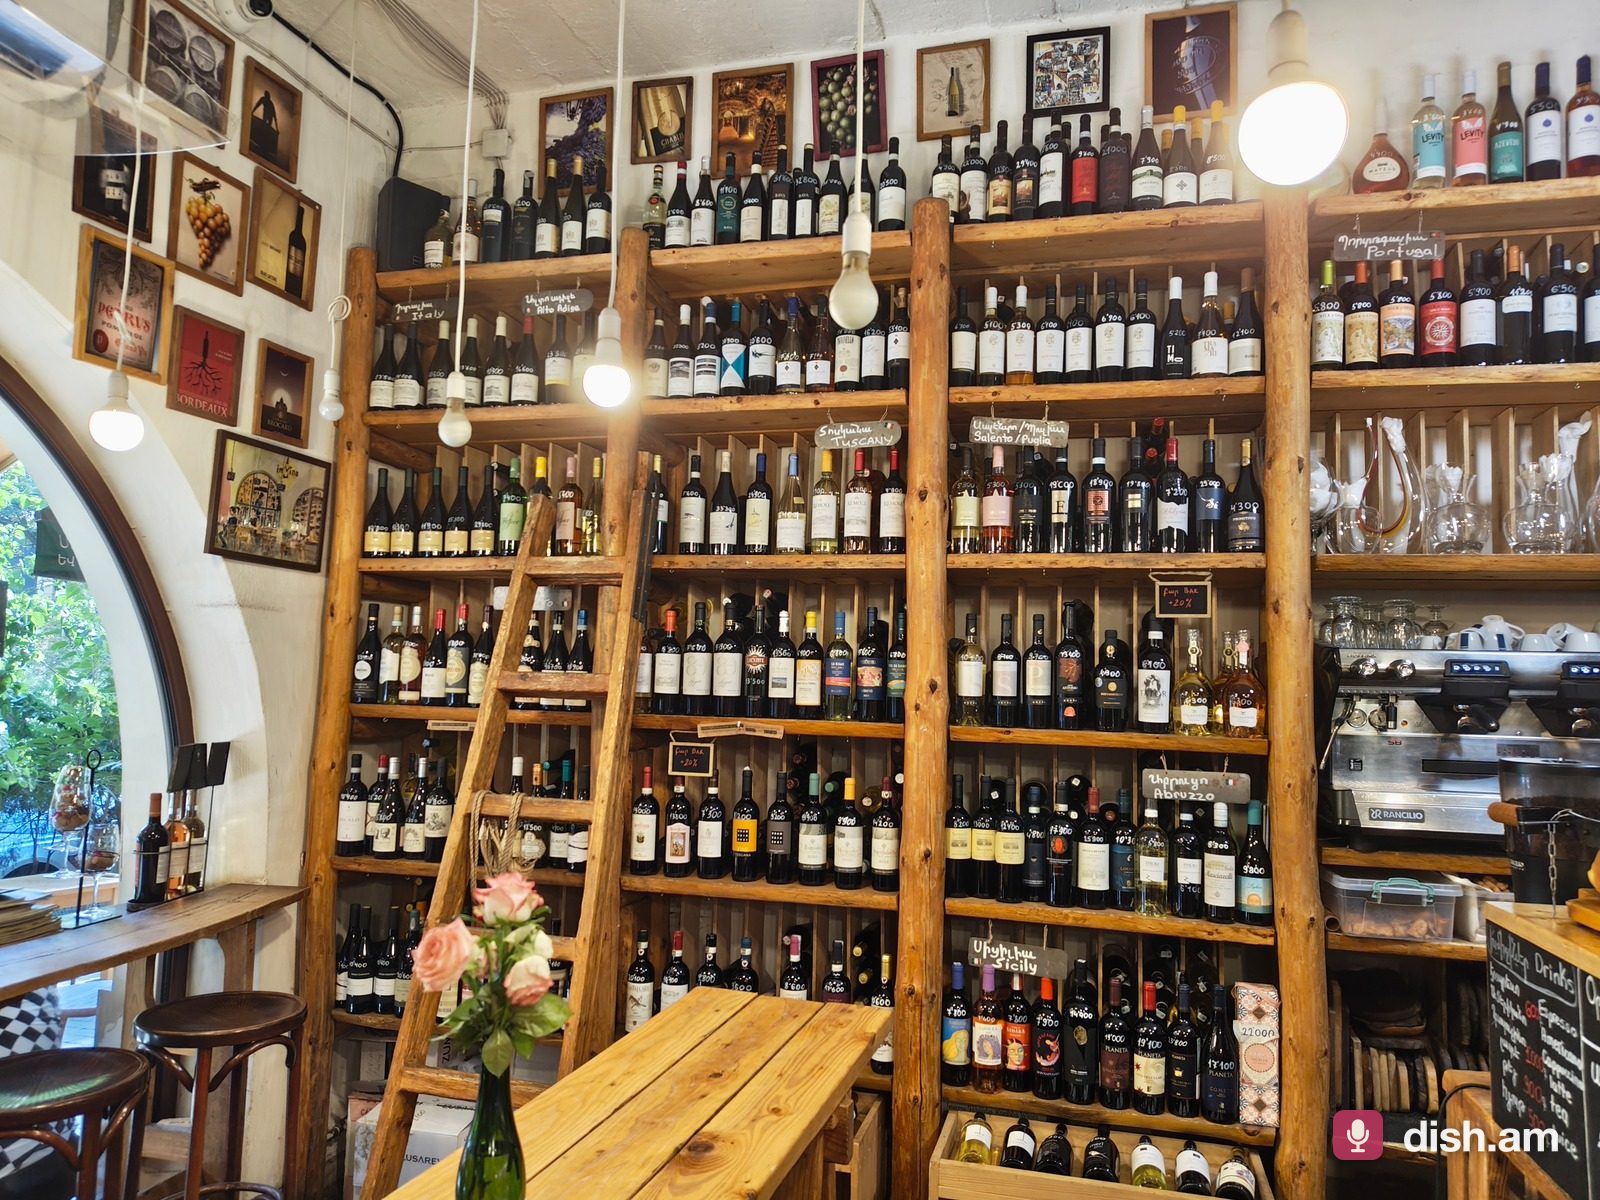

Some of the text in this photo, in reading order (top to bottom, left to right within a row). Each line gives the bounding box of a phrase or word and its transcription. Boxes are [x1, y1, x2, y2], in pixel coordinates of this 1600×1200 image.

[1367, 243, 1438, 260] Portugal
[412, 310, 445, 320] Italy
[537, 305, 554, 315] Alto
[831, 435, 893, 448] TUSCANY
[1154, 788, 1215, 801] Abruzzo
[1383, 810, 1424, 820] RANCILIO
[991, 958, 1039, 976] Sicily
[1535, 951, 1576, 994] Drinks
[1105, 1045, 1129, 1053] PLANETA
[1207, 1070, 1234, 1080] PLANETA
